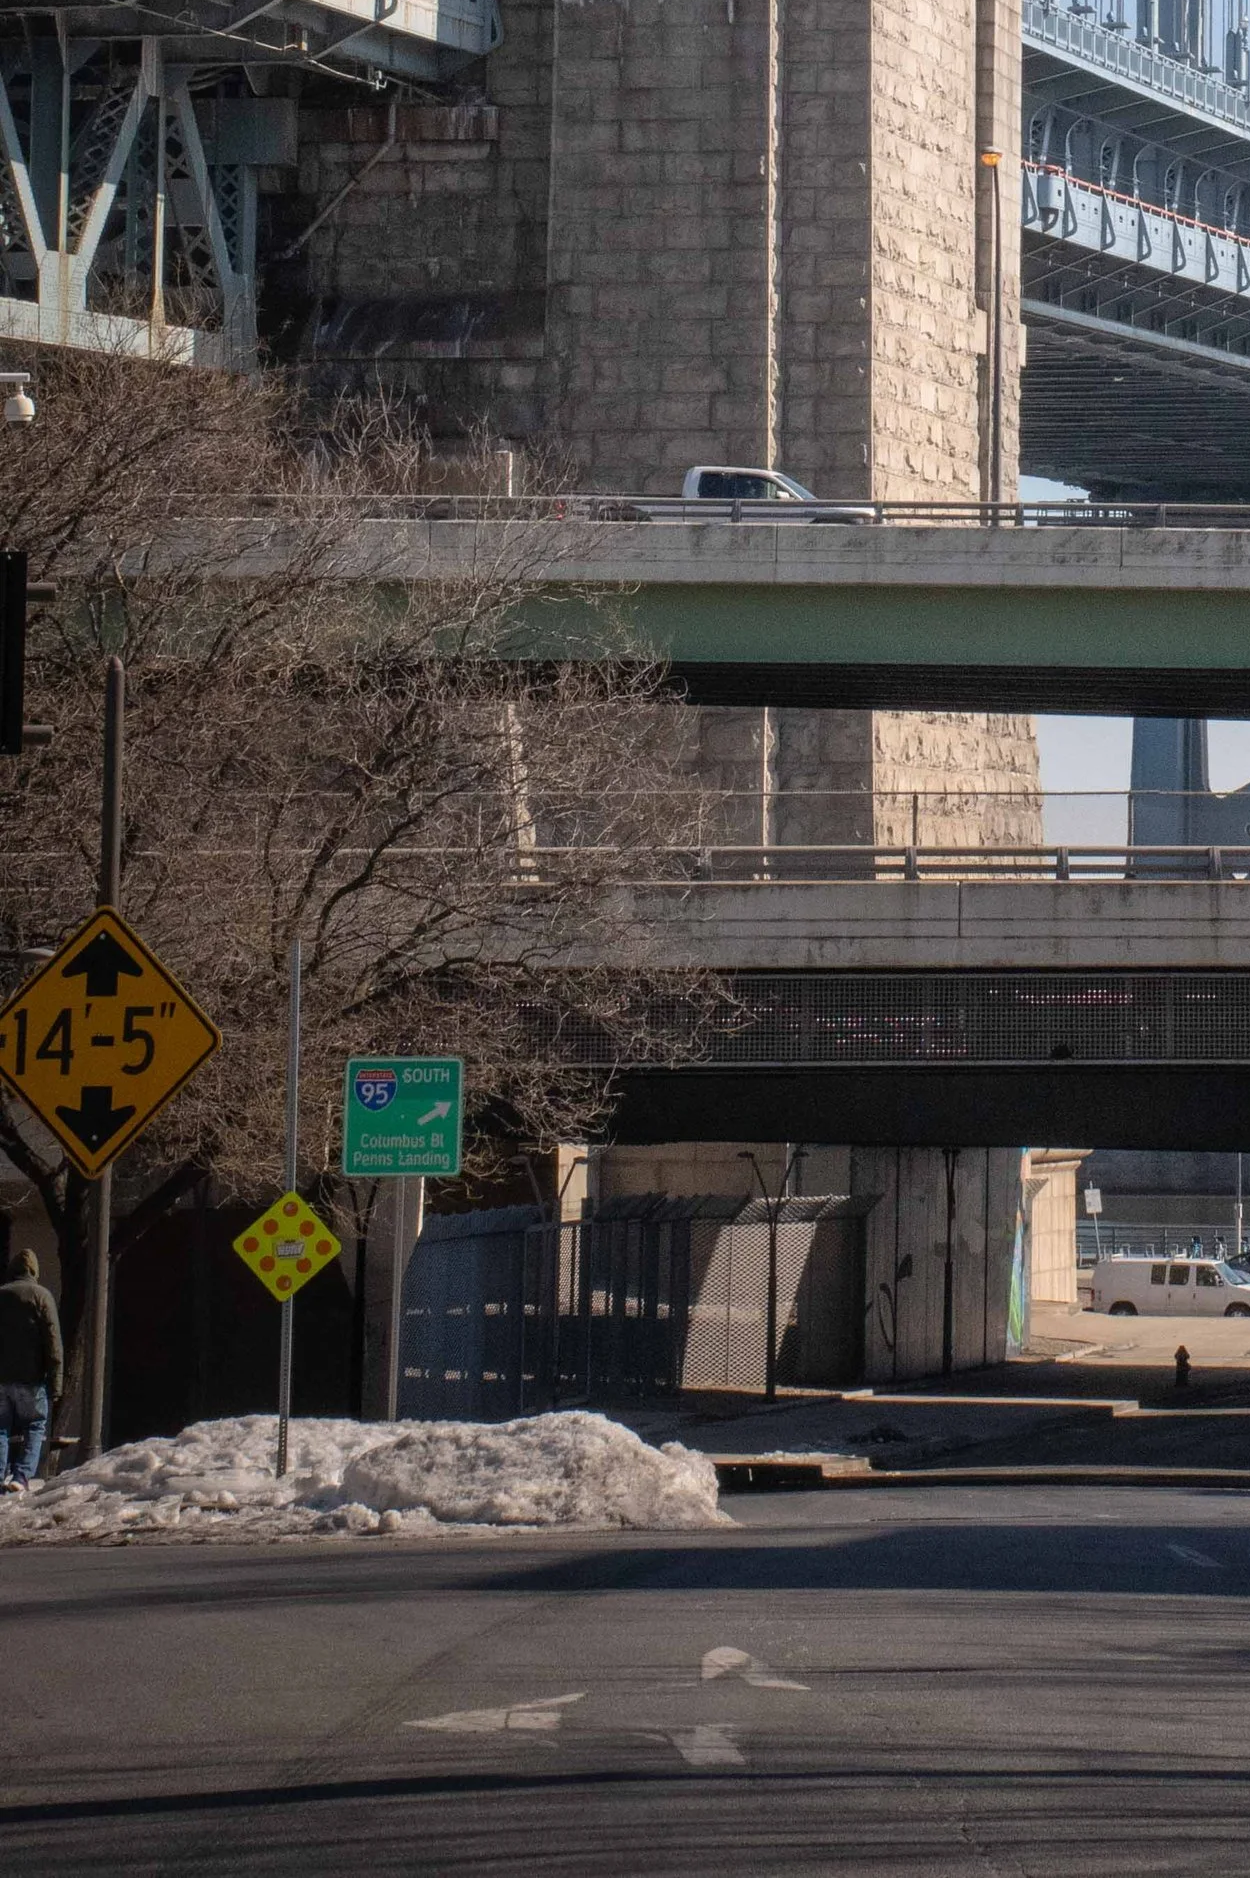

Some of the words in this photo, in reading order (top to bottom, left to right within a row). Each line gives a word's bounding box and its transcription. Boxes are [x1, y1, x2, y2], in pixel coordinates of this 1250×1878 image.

[402, 1068, 450, 1083] SOUTH
[361, 1083, 388, 1104] 95
[361, 1133, 425, 1148] Columbus
[353, 1151, 393, 1165] Penns
[398, 1151, 450, 1169] Landing
